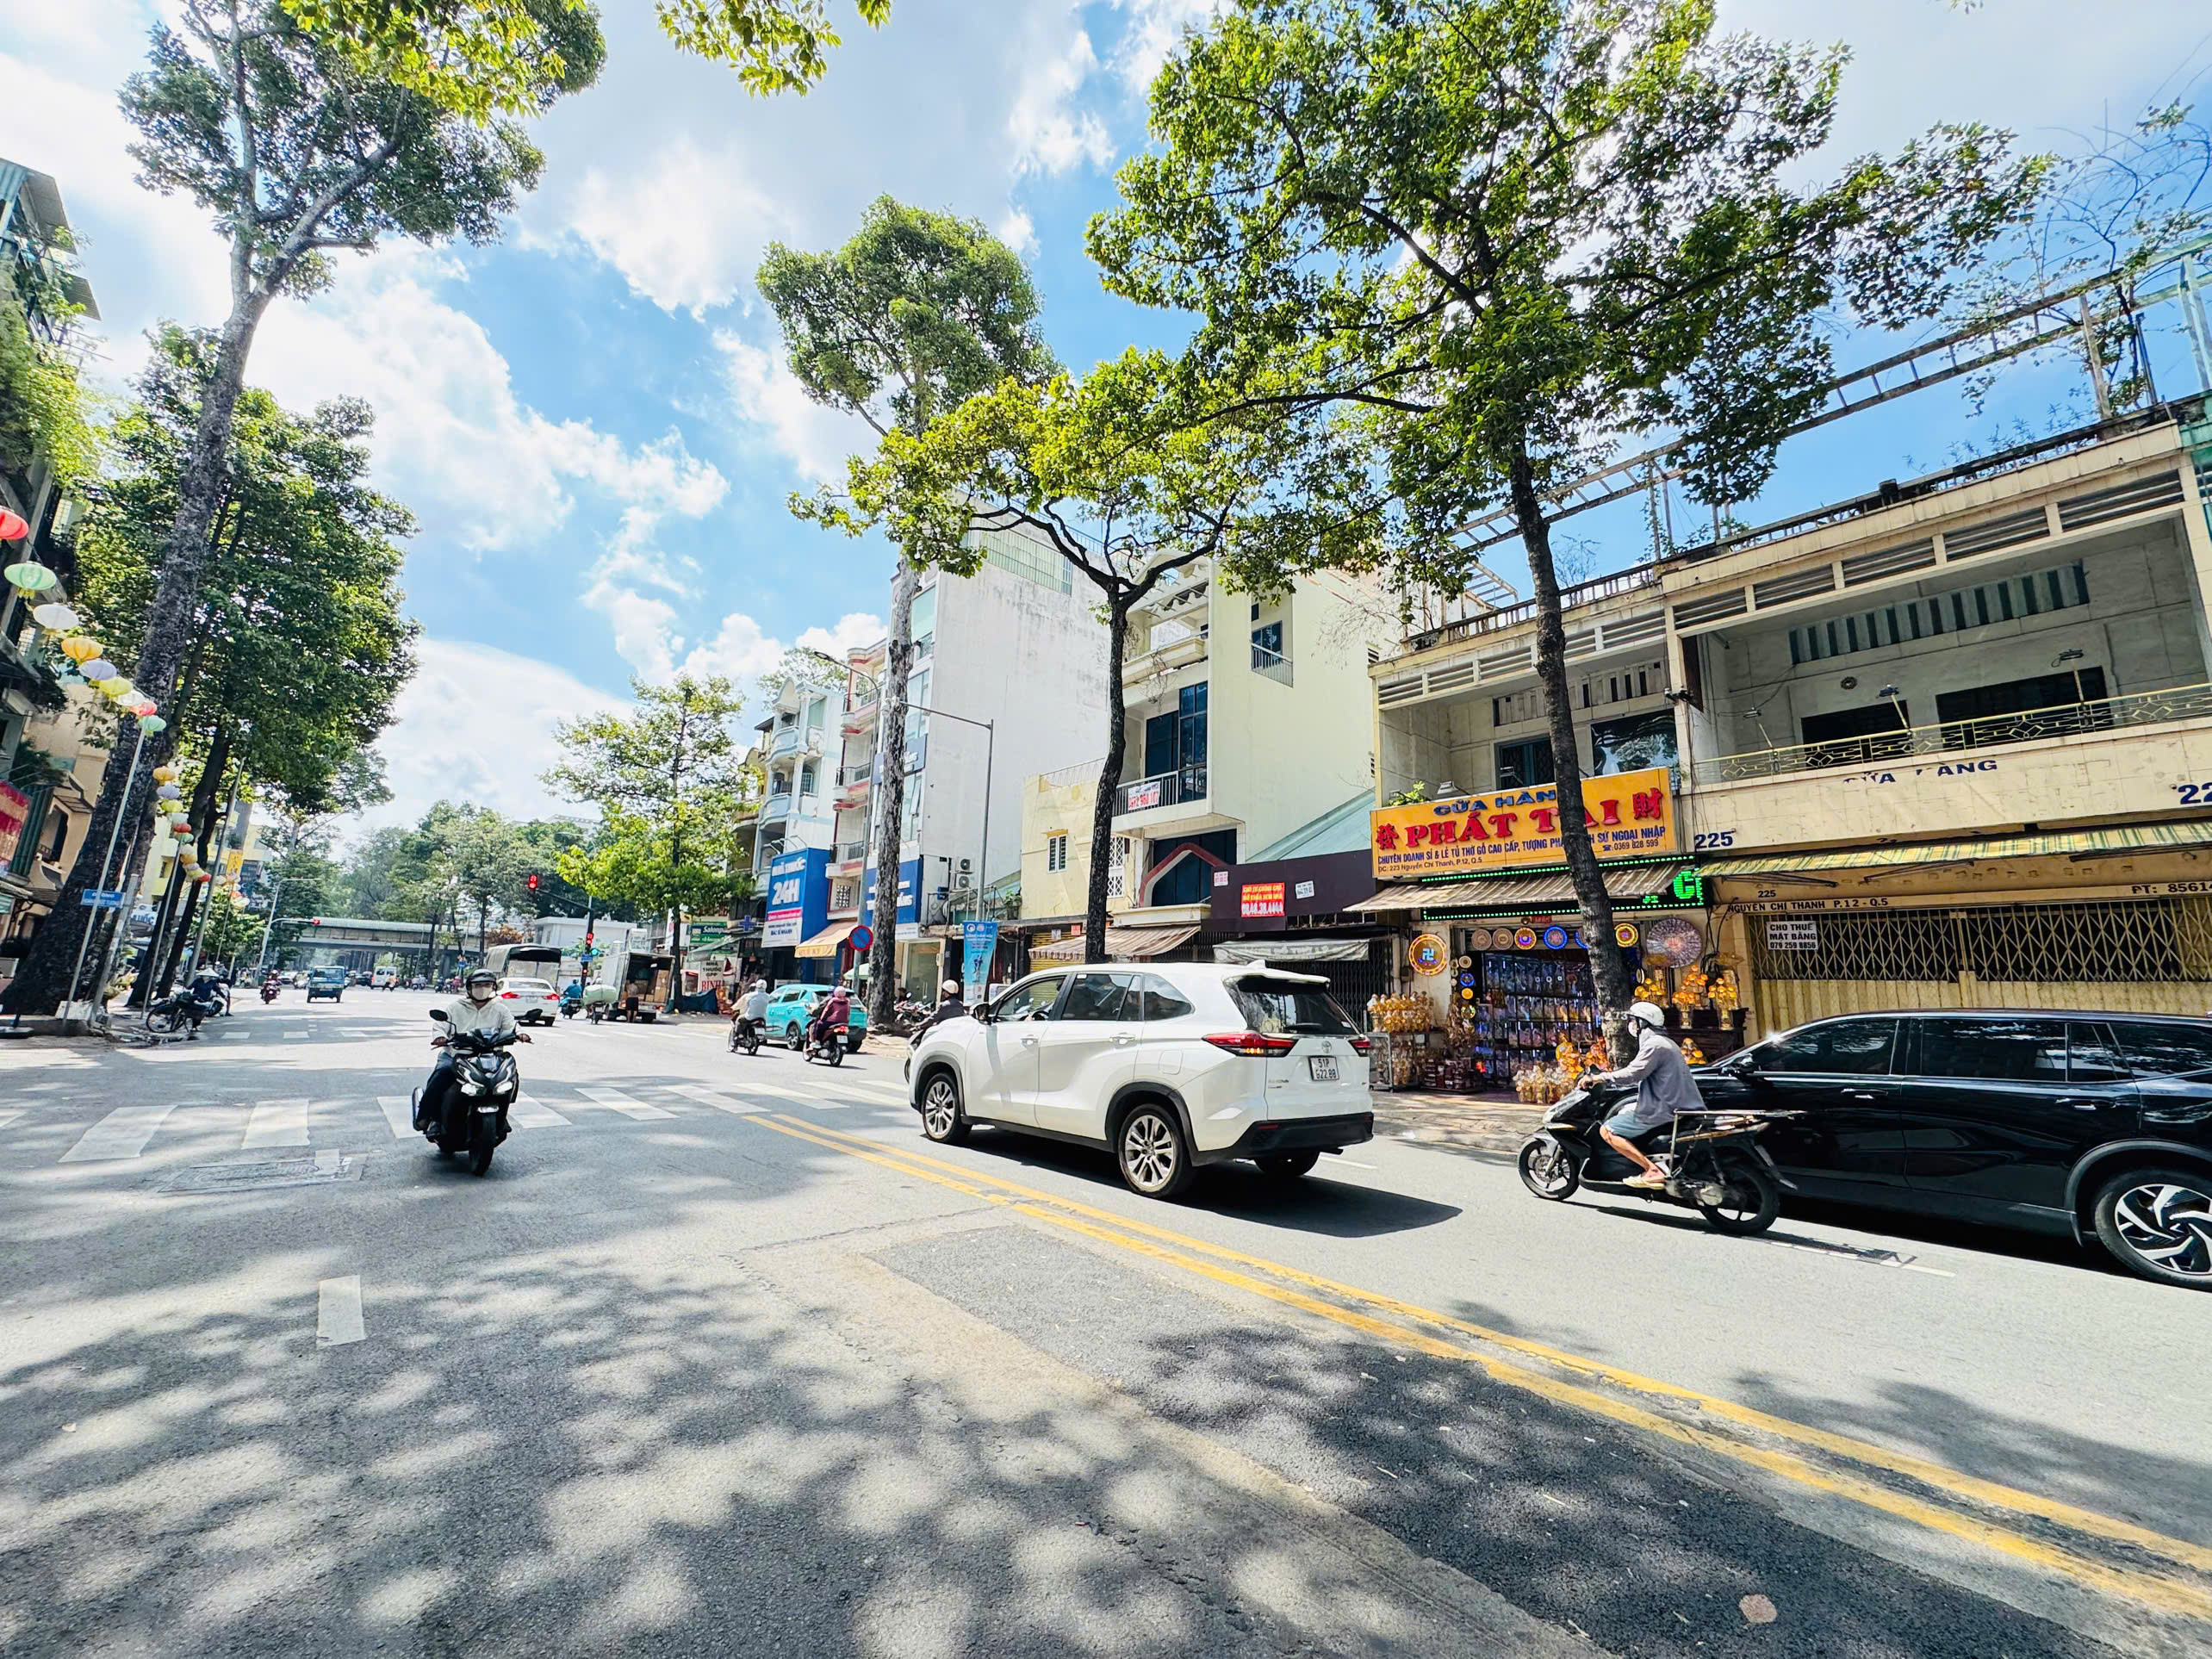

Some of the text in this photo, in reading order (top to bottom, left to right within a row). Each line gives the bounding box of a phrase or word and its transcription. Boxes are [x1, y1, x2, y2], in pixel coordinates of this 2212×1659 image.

[1495, 790, 1556, 808] HÀN
[1405, 811, 1518, 848] PHÁT
[1403, 852, 1424, 862] DOANH
[1488, 844, 1501, 854] CAO
[1641, 825, 1666, 839] NHẬP
[1694, 830, 1734, 848] 225
[772, 878, 800, 905] 24H
[1791, 901, 1825, 910] THANH
[1605, 1011, 1628, 1021] 273
